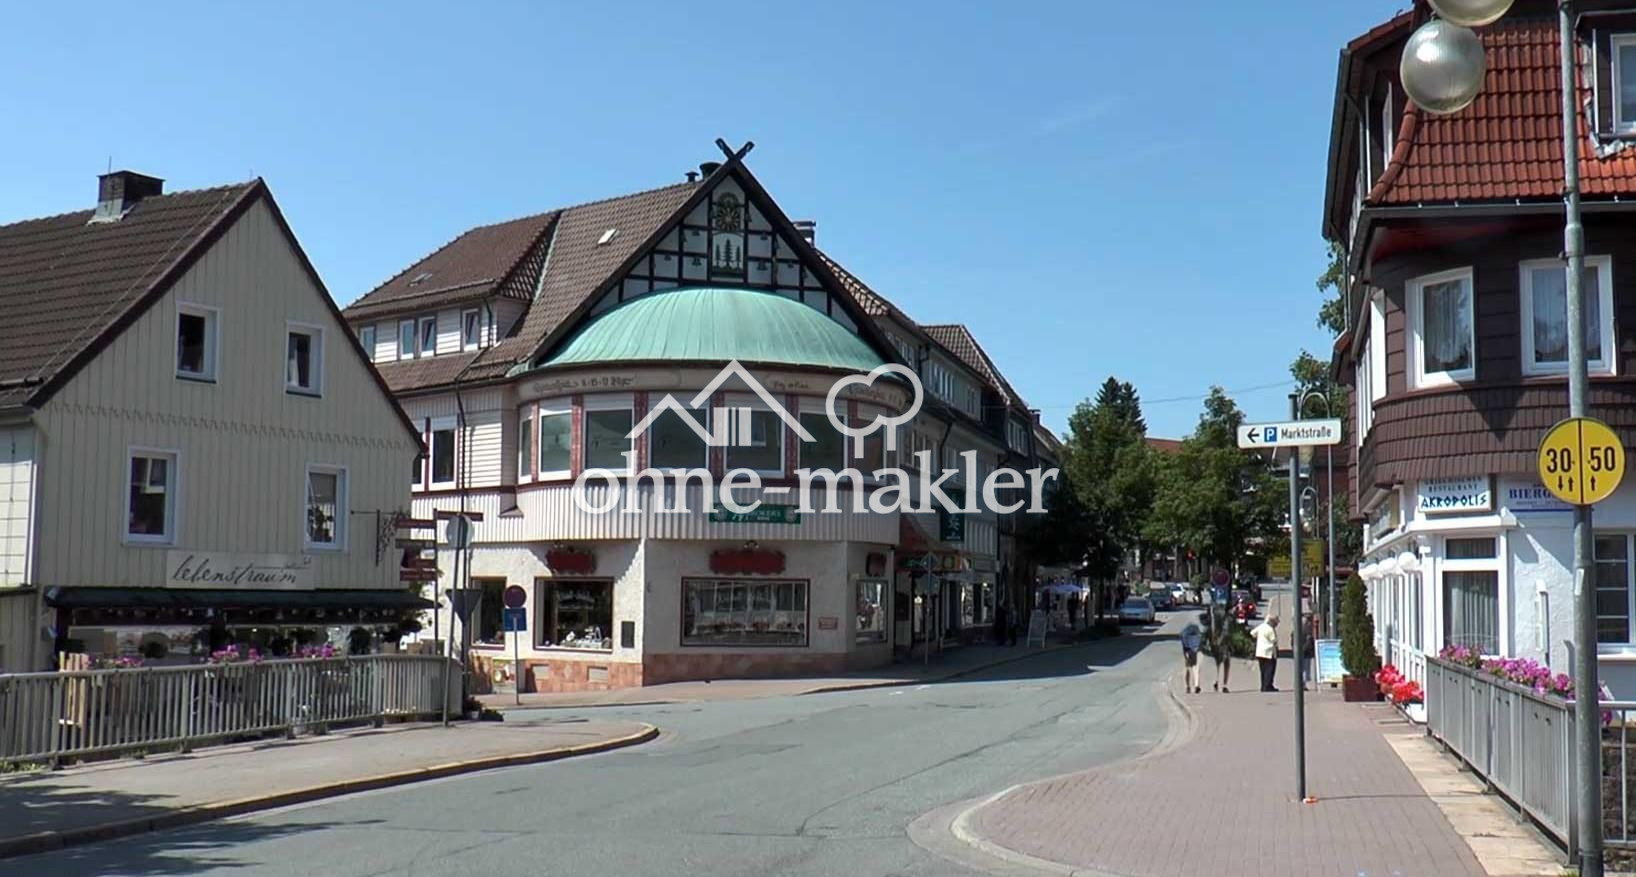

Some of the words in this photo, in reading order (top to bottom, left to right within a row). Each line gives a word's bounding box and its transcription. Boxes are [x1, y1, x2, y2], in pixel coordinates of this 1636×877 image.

[1267, 428, 1274, 439] P
[1281, 426, 1332, 439] Marktstraße
[1546, 448, 1572, 473] 30
[1590, 446, 1616, 472] 50
[1509, 488, 1552, 499] BIERG
[1421, 494, 1487, 508] AKROPOLIS
